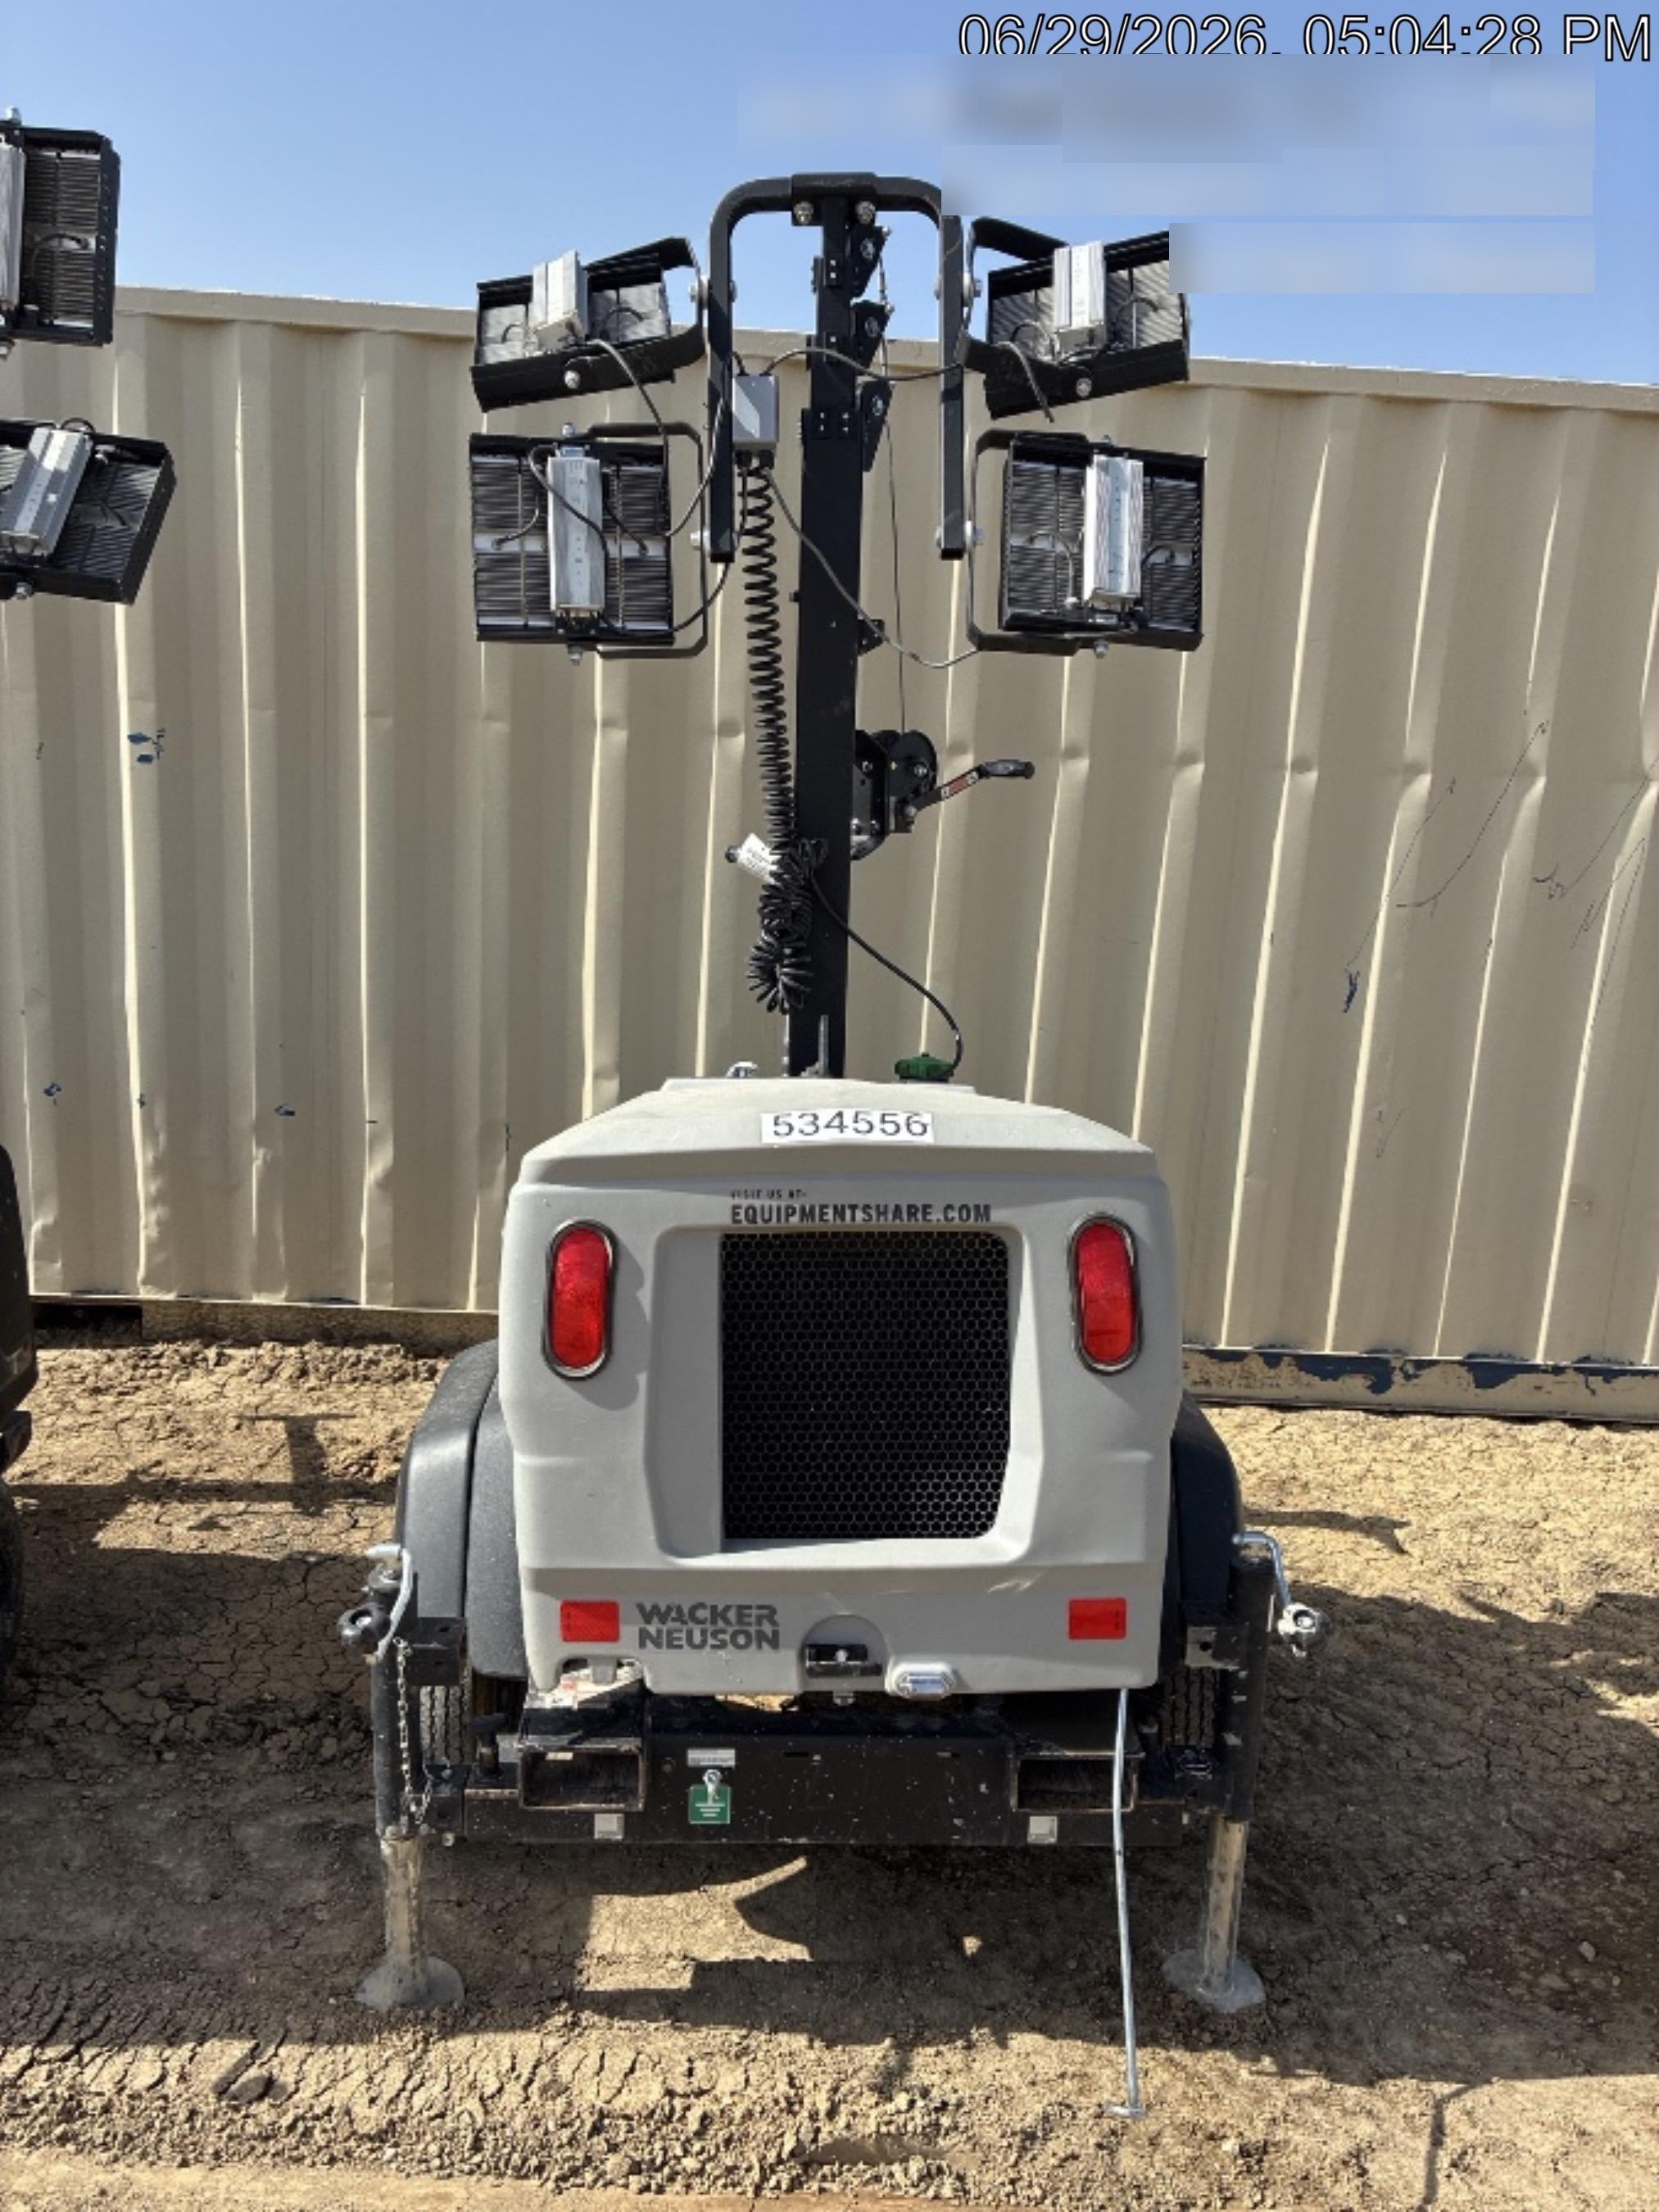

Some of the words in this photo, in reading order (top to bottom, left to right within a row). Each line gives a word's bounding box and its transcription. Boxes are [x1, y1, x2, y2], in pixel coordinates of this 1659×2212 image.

[773, 1111, 930, 1136] 534556
[732, 1203, 990, 1224] EQUIPMENTSHARE.COM
[636, 1602, 779, 1626] WACKER
[638, 1626, 780, 1650] NEUSON
